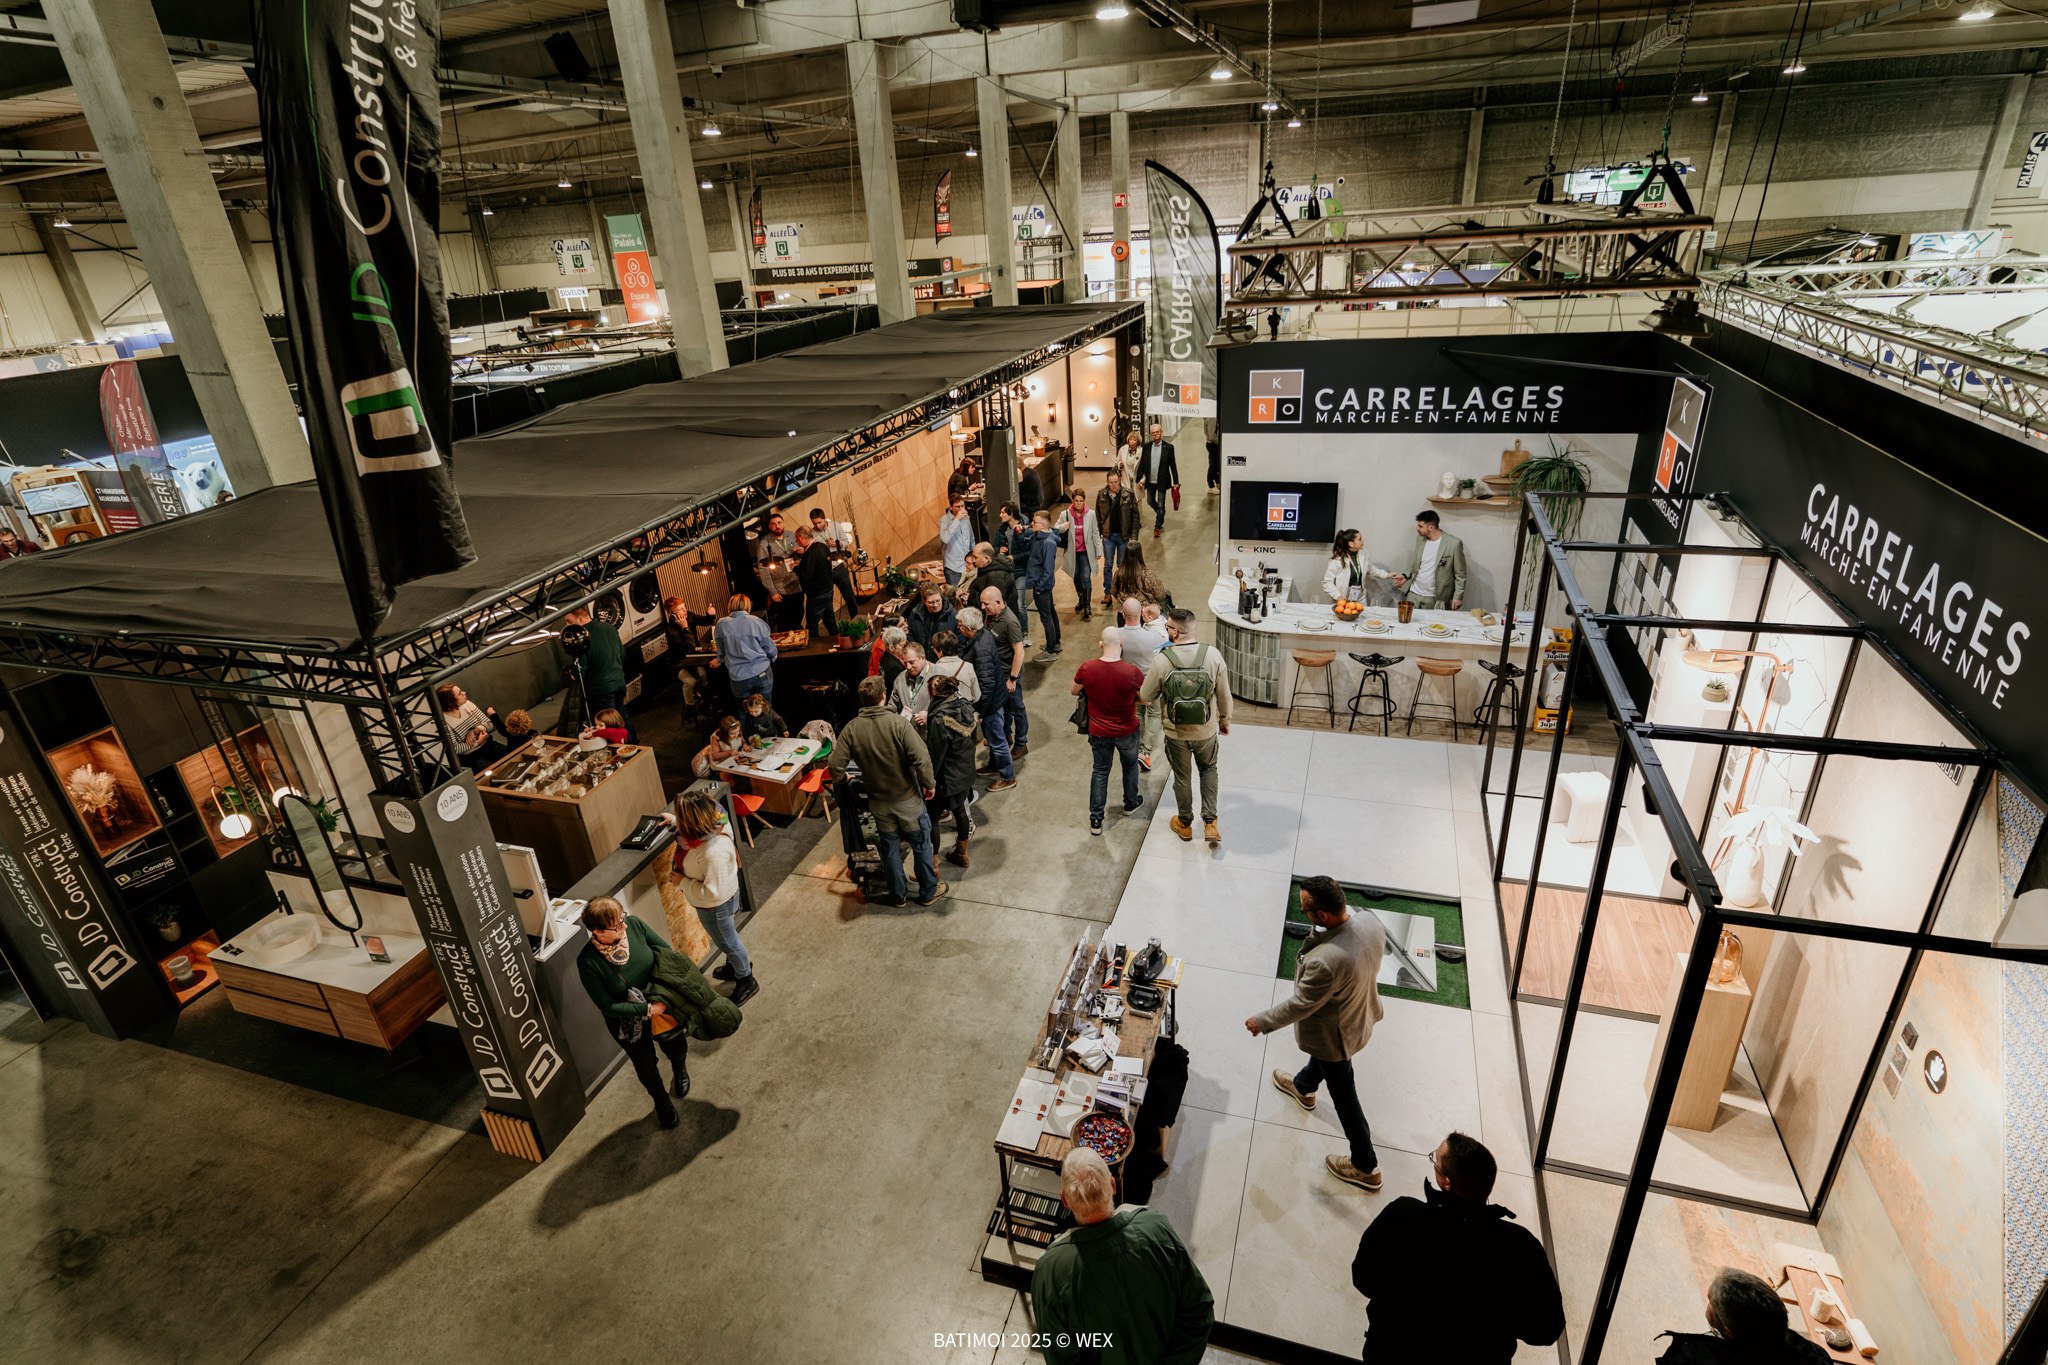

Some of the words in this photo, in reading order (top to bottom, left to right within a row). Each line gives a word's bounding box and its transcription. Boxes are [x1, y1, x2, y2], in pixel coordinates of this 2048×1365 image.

[394, 44, 417, 68] &
[2018, 154, 2039, 187] PALAIS
[1280, 190, 1289, 203] 4
[1321, 187, 1331, 199] D
[1034, 208, 1043, 219] C
[787, 226, 797, 236] B
[614, 239, 635, 248] Palais
[772, 269, 787, 277] PLUS
[788, 268, 796, 276] DE
[797, 268, 805, 276] 30
[806, 267, 817, 275] ANS
[860, 264, 869, 273] EN
[906, 261, 918, 270] OIS
[560, 289, 586, 297] SILVELOX
[630, 292, 650, 301] Espace
[1273, 378, 1282, 389] K
[1314, 385, 1565, 411] CARRELAGES
[1316, 410, 1560, 423] MARCHE-EN-FAMENNE
[1680, 399, 1689, 424] K
[1807, 483, 2031, 676] CARRELAGES
[1800, 521, 2010, 710] MARCHE-EN-FAMENNE
[1540, 721, 1556, 729] Jupi
[439, 800, 449, 810] 10
[449, 789, 464, 804] ANS
[387, 808, 395, 817] 10
[396, 809, 411, 820] ANS
[68, 852, 79, 860] &
[131, 870, 141, 878] JD
[142, 857, 174, 873] Construct
[37, 838, 91, 920] Construct
[478, 880, 485, 888] et
[507, 914, 519, 938] frère
[78, 922, 109, 947] JD
[41, 933, 63, 958] JD
[514, 937, 522, 946] &
[467, 967, 476, 976] &
[490, 922, 530, 1018] Construct
[441, 942, 484, 1029] Construct
[519, 1019, 542, 1049] JD
[473, 1035, 498, 1063] JD
